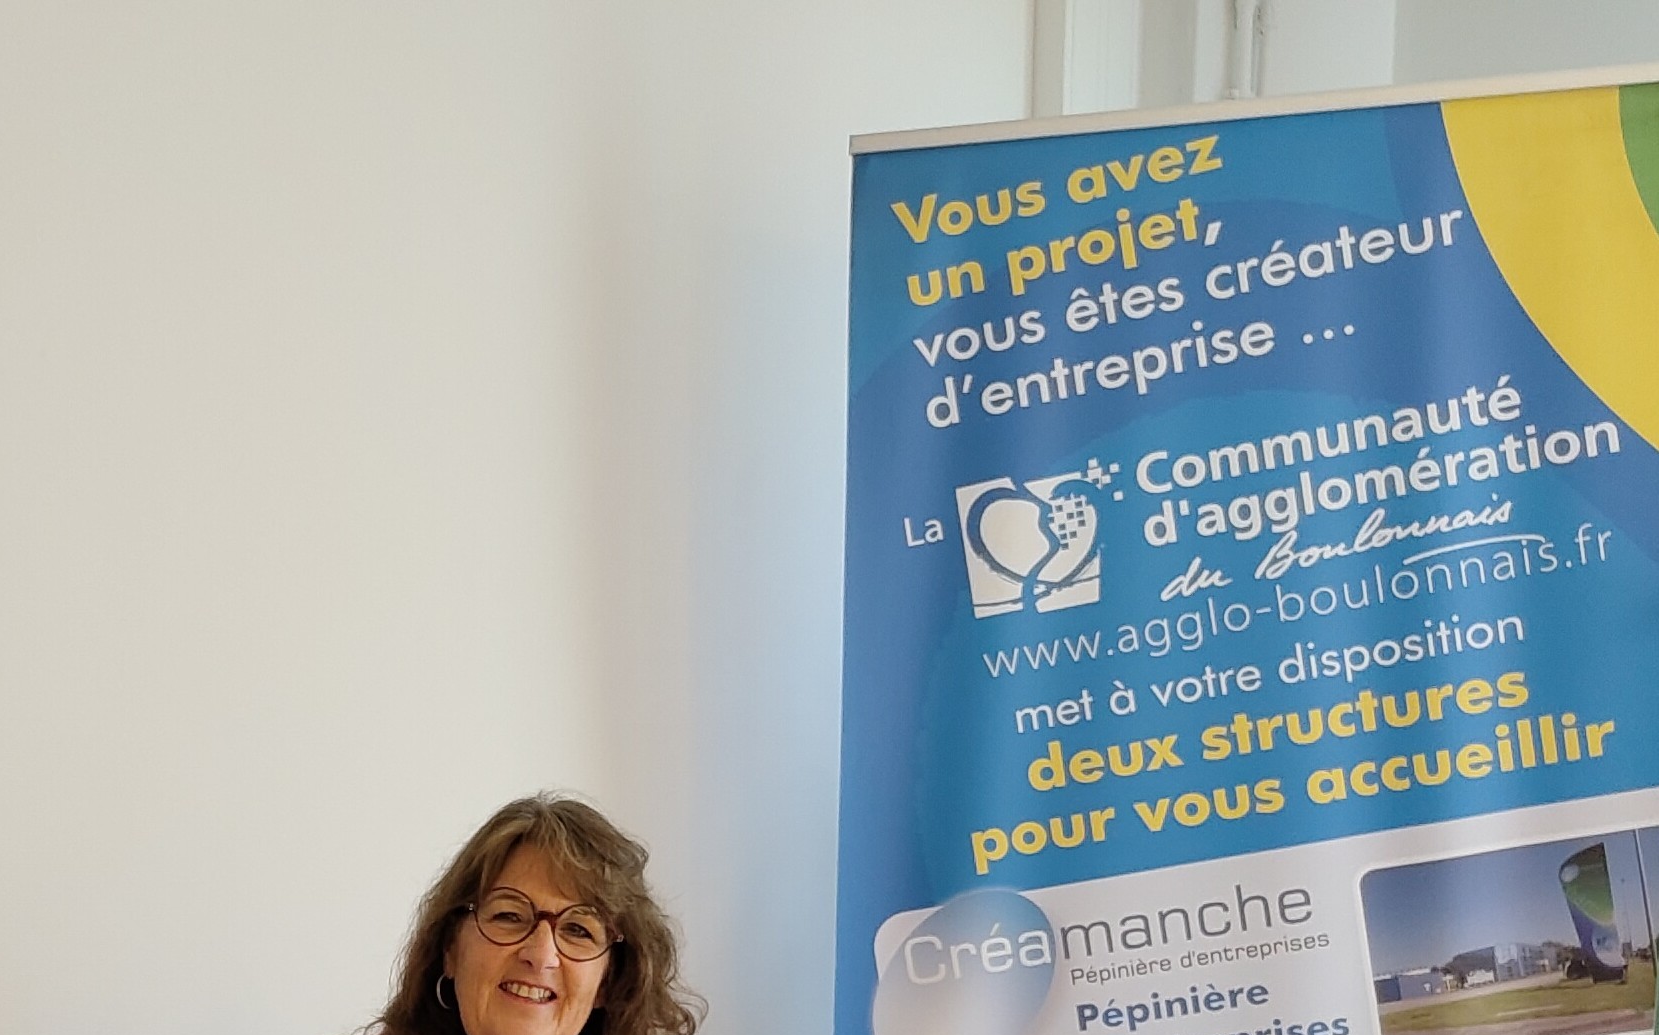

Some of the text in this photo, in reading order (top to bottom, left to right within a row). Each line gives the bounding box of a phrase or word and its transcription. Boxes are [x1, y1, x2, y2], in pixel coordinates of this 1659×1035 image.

[892, 133, 1223, 246] Vous avez
[907, 198, 1222, 307] un projet,
[913, 208, 1462, 368] vous êtes créateur
[1136, 376, 1521, 496] Communauté
[1144, 417, 1620, 547] d'agglomération
[903, 515, 944, 549] La
[1161, 495, 1513, 601] du Boulonnais
[983, 525, 1612, 678] www.agglo-boulonnais.fr
[1014, 614, 1525, 734] met à votre disposition
[1028, 671, 1529, 793] deux structures
[970, 714, 1614, 875] pour vous accueillir
[902, 880, 1314, 987] Créamanche
[1070, 929, 1330, 987] Pépinière d'entreprises
[1075, 980, 1269, 1032] Pépinière
